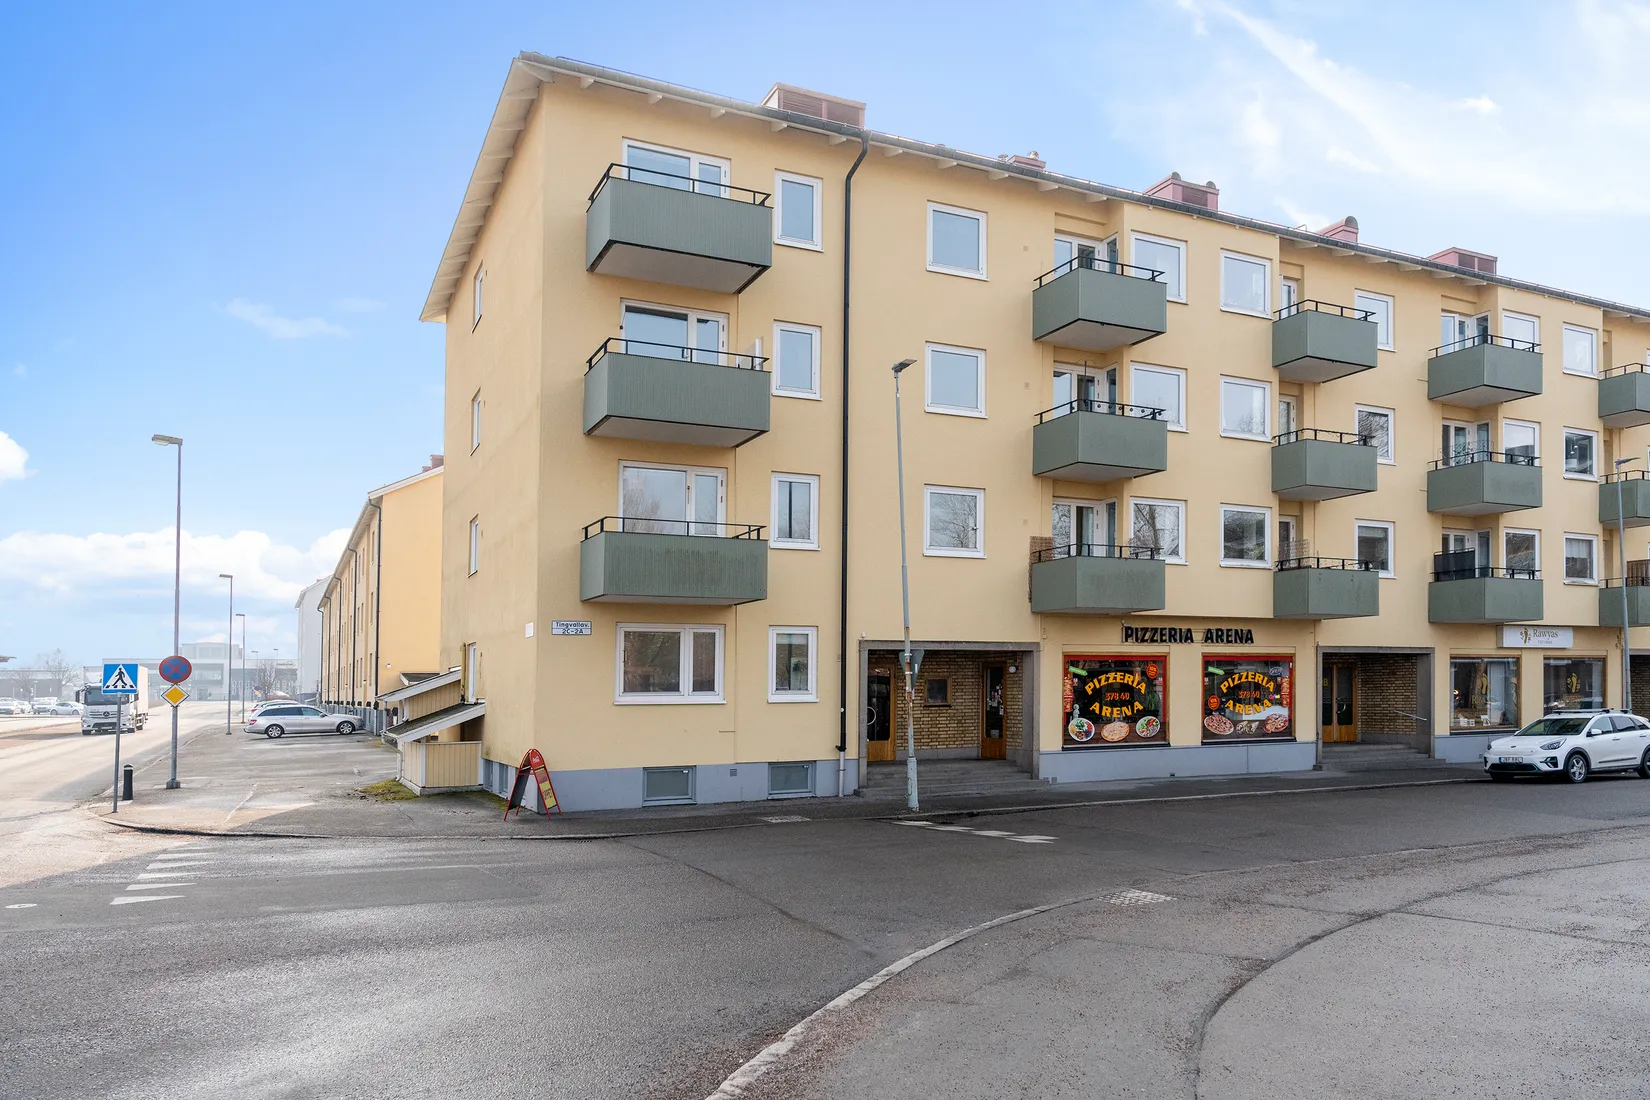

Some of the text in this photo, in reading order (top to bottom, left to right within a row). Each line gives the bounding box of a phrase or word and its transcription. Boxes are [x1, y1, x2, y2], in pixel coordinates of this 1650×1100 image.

[1123, 625, 1254, 644] PIZZERIA ARENA
[1533, 628, 1558, 640] Rawyas
[1084, 671, 1147, 695] PIZZERIA
[1220, 671, 1275, 693] PIZZERIA
[1089, 701, 1144, 718] ARENA
[1225, 699, 1272, 715] ARENA
